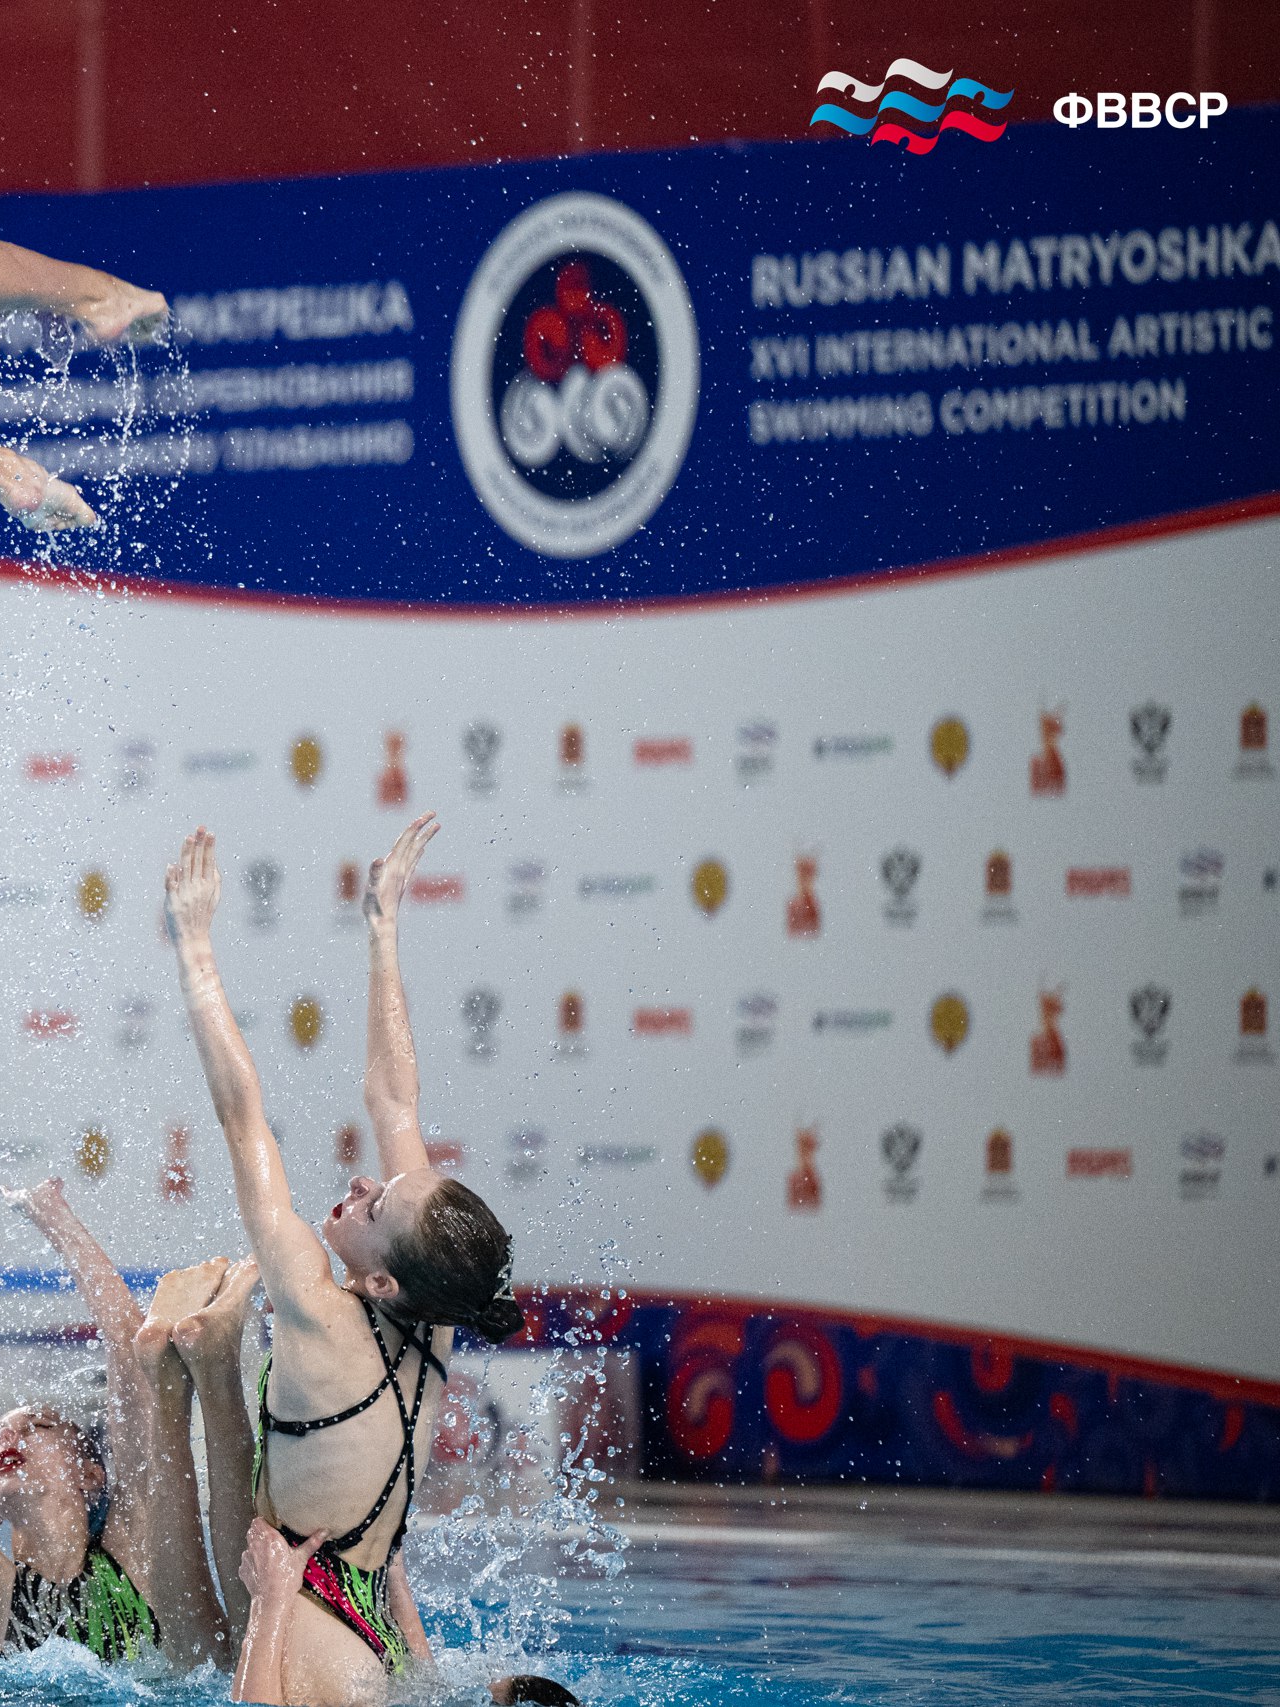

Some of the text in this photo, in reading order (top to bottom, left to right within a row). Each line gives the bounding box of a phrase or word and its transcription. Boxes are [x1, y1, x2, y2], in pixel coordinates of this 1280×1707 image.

[753, 221, 1280, 307] RUSSIAN MATRYOSHKA
[751, 305, 1273, 379] XVI INTERNATIONAL ARTISTIC
[750, 378, 1186, 444] SWIMMING COMPETITION
